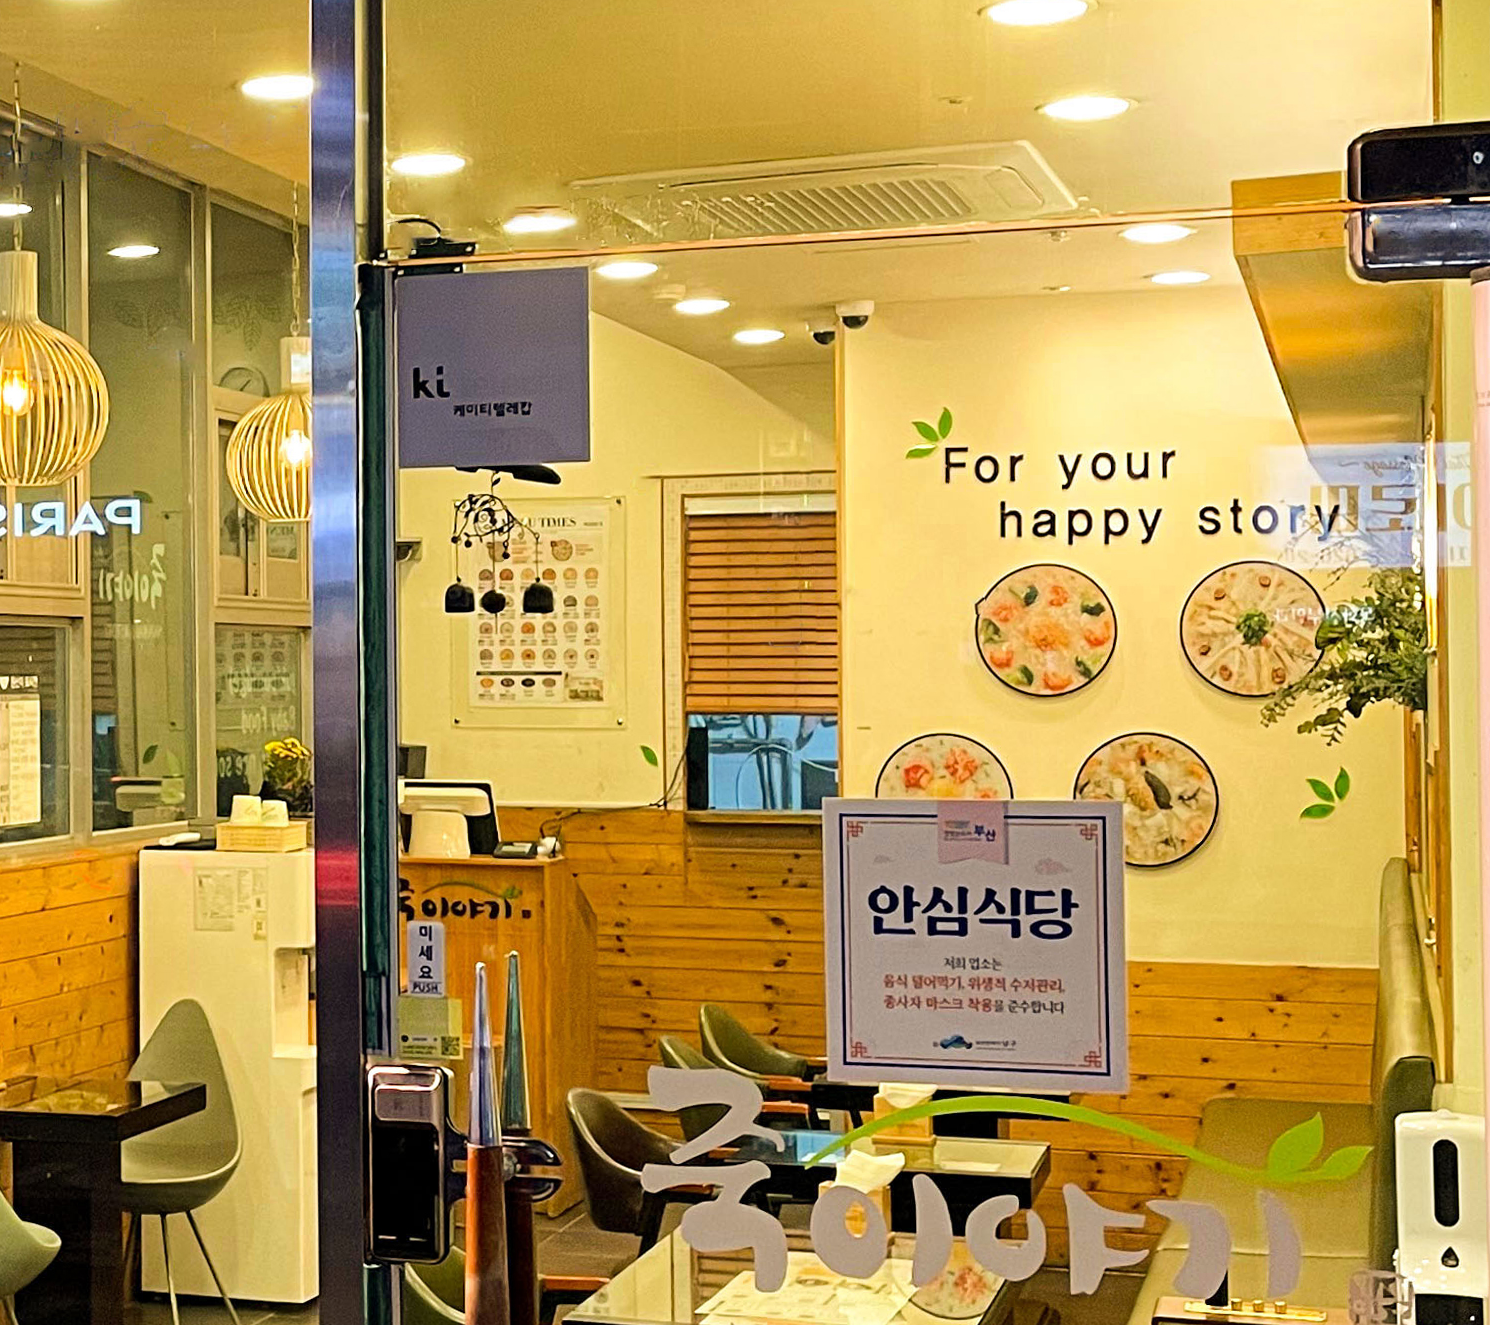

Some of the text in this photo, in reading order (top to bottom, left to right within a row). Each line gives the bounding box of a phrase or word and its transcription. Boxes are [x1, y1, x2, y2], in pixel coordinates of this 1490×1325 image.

[943, 446, 1177, 490] For your
[539, 517, 577, 528] TIMES
[998, 497, 1342, 546] happy story
[867, 884, 1080, 941] 안심식당
[418, 925, 434, 980] 미세요
[943, 956, 1003, 972] 저희 업소는
[412, 981, 439, 994] PUSH
[883, 974, 908, 989] 음식
[925, 997, 965, 1010] 마스크
[1007, 999, 1065, 1015] 준수합니다
[641, 1065, 1302, 1309] 죽이야기
